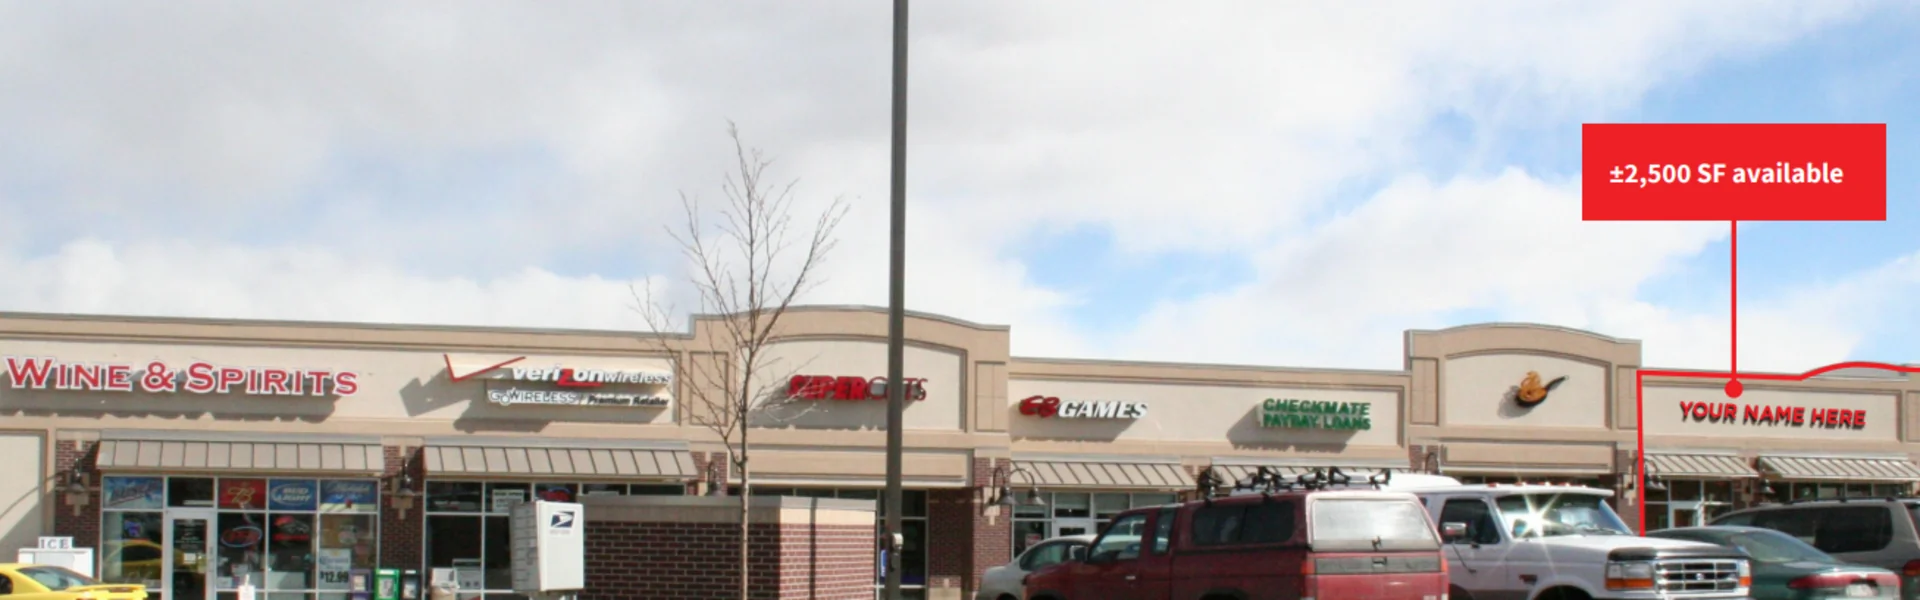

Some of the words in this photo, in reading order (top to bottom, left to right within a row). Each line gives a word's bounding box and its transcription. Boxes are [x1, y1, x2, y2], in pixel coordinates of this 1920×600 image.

[6, 357, 132, 391] WINE
[142, 361, 176, 392] &
[185, 362, 359, 395] SPIRITS
[1058, 400, 1148, 419] GAMES
[1263, 398, 1371, 415] CHECKMATE
[1263, 414, 1318, 428] PAYDAY
[1324, 415, 1371, 430] LOANS
[40, 539, 70, 549] ICE
